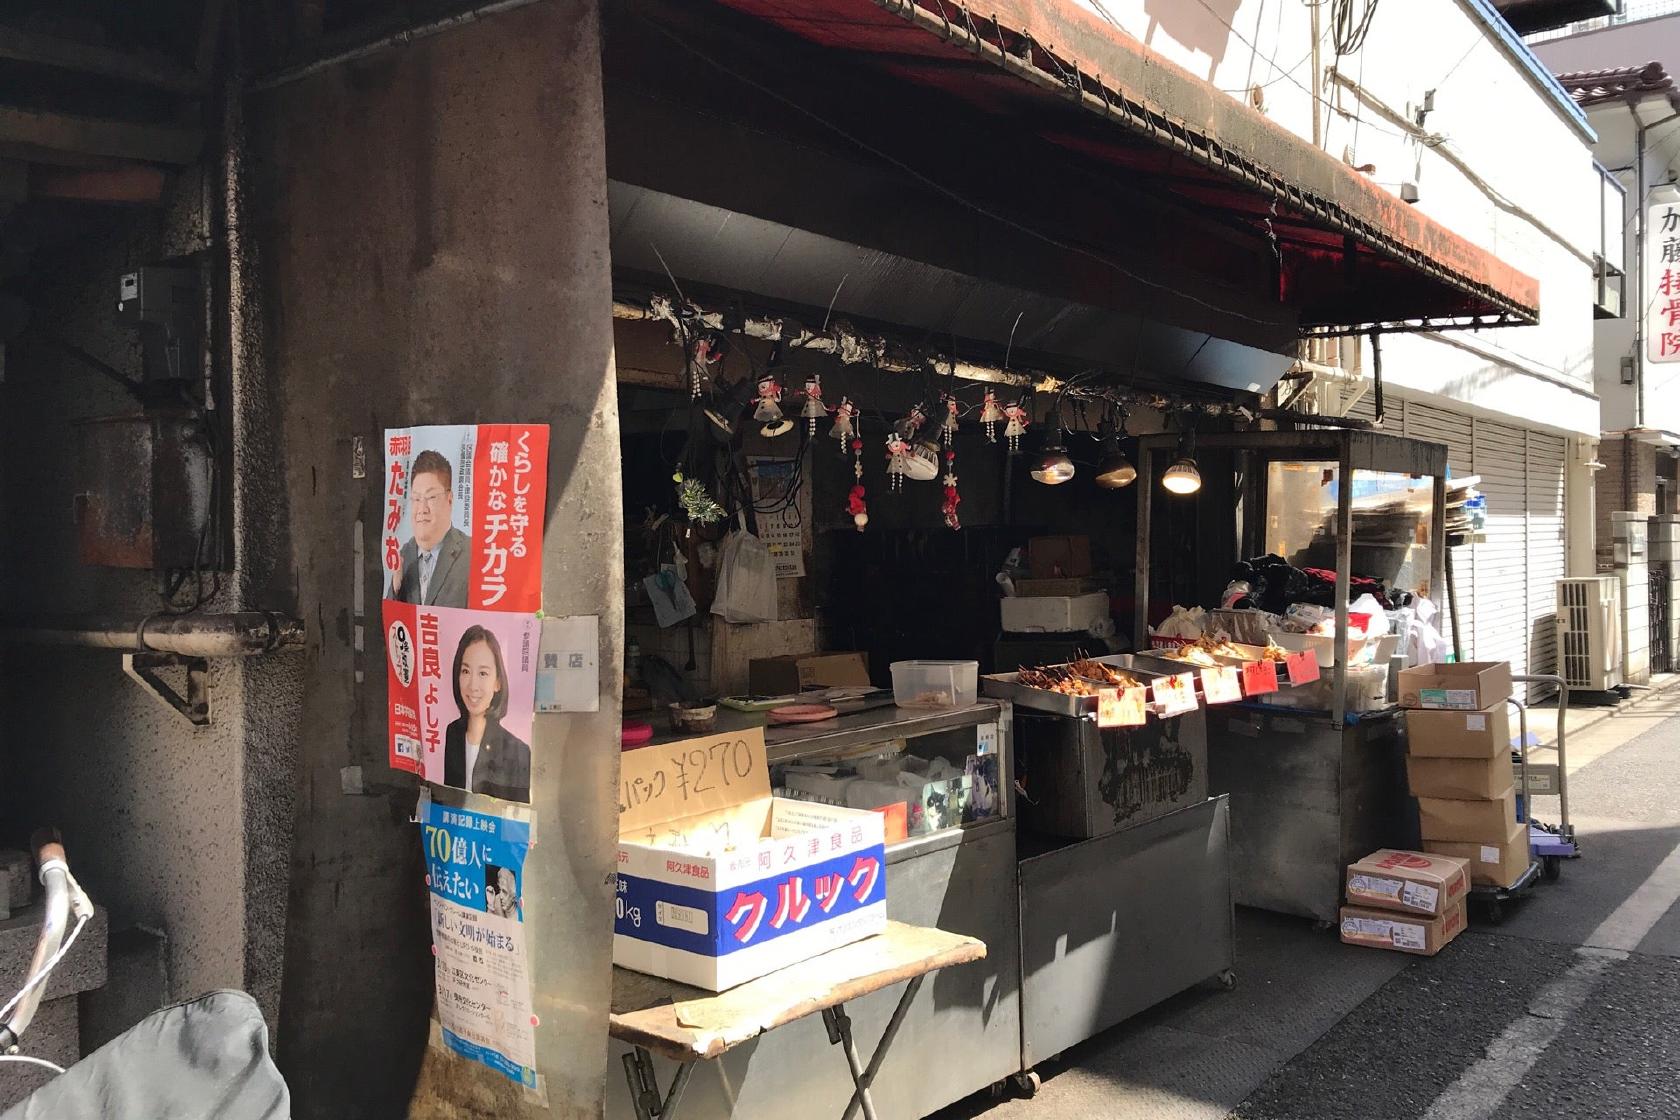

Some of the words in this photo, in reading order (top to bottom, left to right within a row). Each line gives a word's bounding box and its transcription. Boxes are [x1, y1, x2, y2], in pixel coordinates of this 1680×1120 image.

[480, 441, 511, 606] 確かなチカラ
[509, 430, 532, 558] くらしを守る
[420, 612, 442, 753] 吉良よし子
[671, 740, 752, 801] ¥270
[425, 825, 493, 868] 70億人に
[431, 863, 480, 900] 伝えたい
[666, 860, 710, 879] 阿久津食品
[724, 856, 880, 944] クルック
